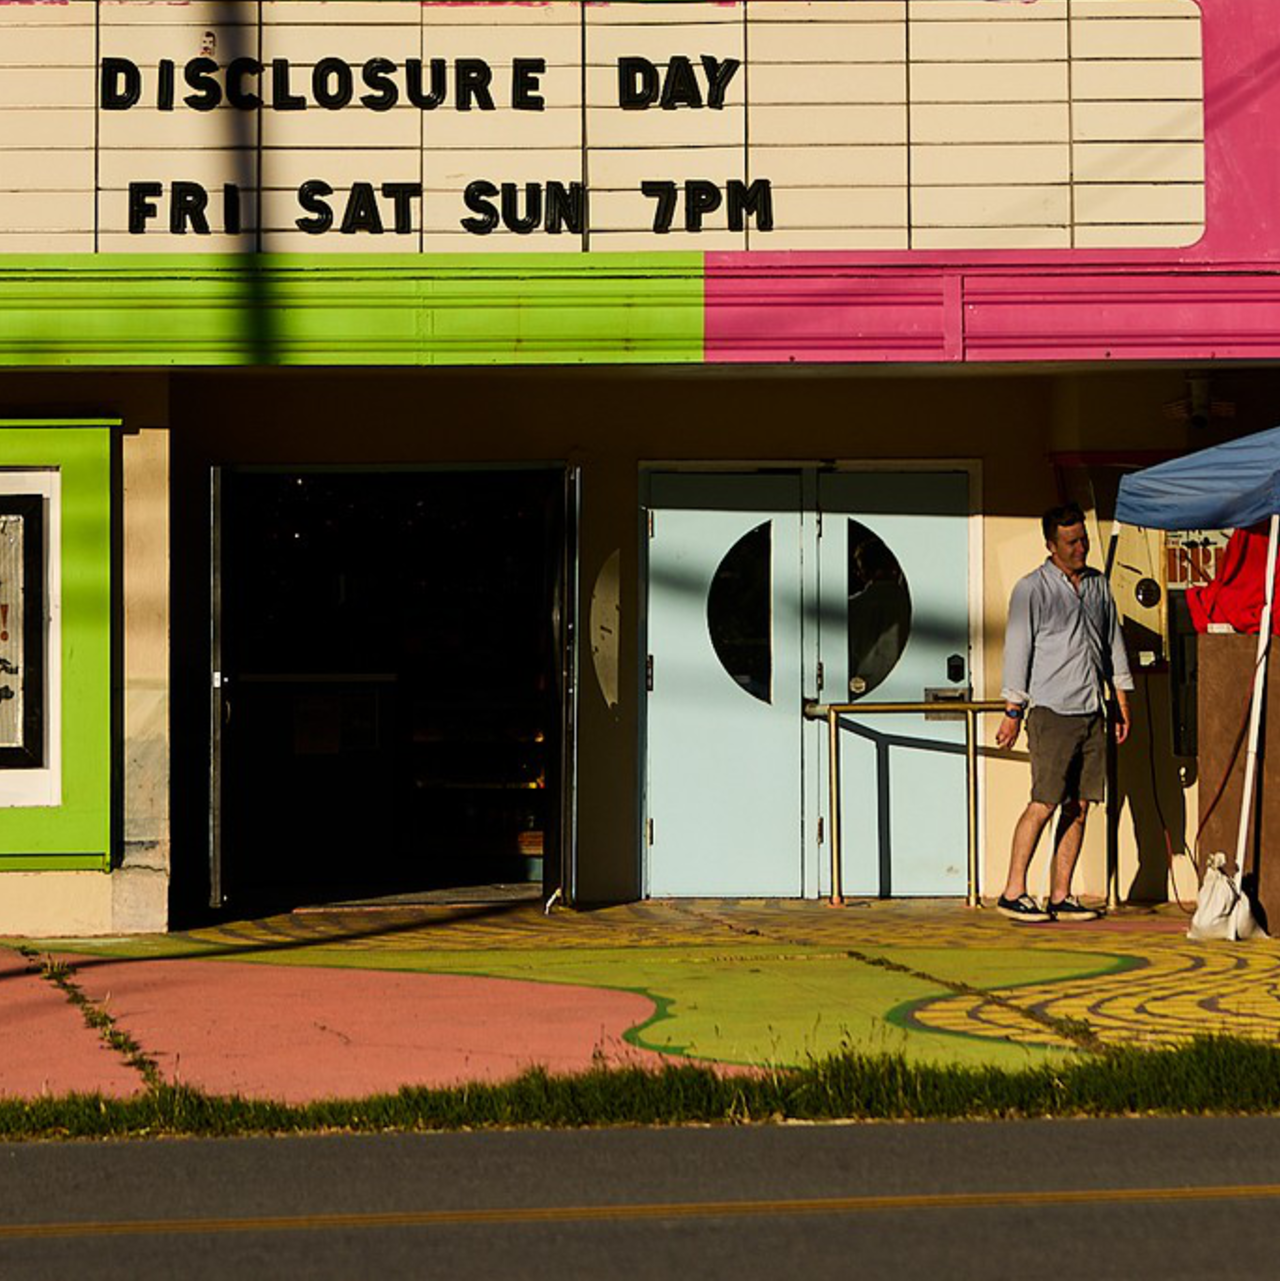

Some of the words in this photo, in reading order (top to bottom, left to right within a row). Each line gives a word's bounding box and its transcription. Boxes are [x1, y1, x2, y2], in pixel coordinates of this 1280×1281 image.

[100, 56, 547, 111] DISCLOSURE
[618, 54, 741, 111] DAY
[127, 180, 241, 236] FRI
[295, 179, 422, 235] SAT
[460, 180, 586, 235] SUN
[640, 178, 775, 234] 7PM
